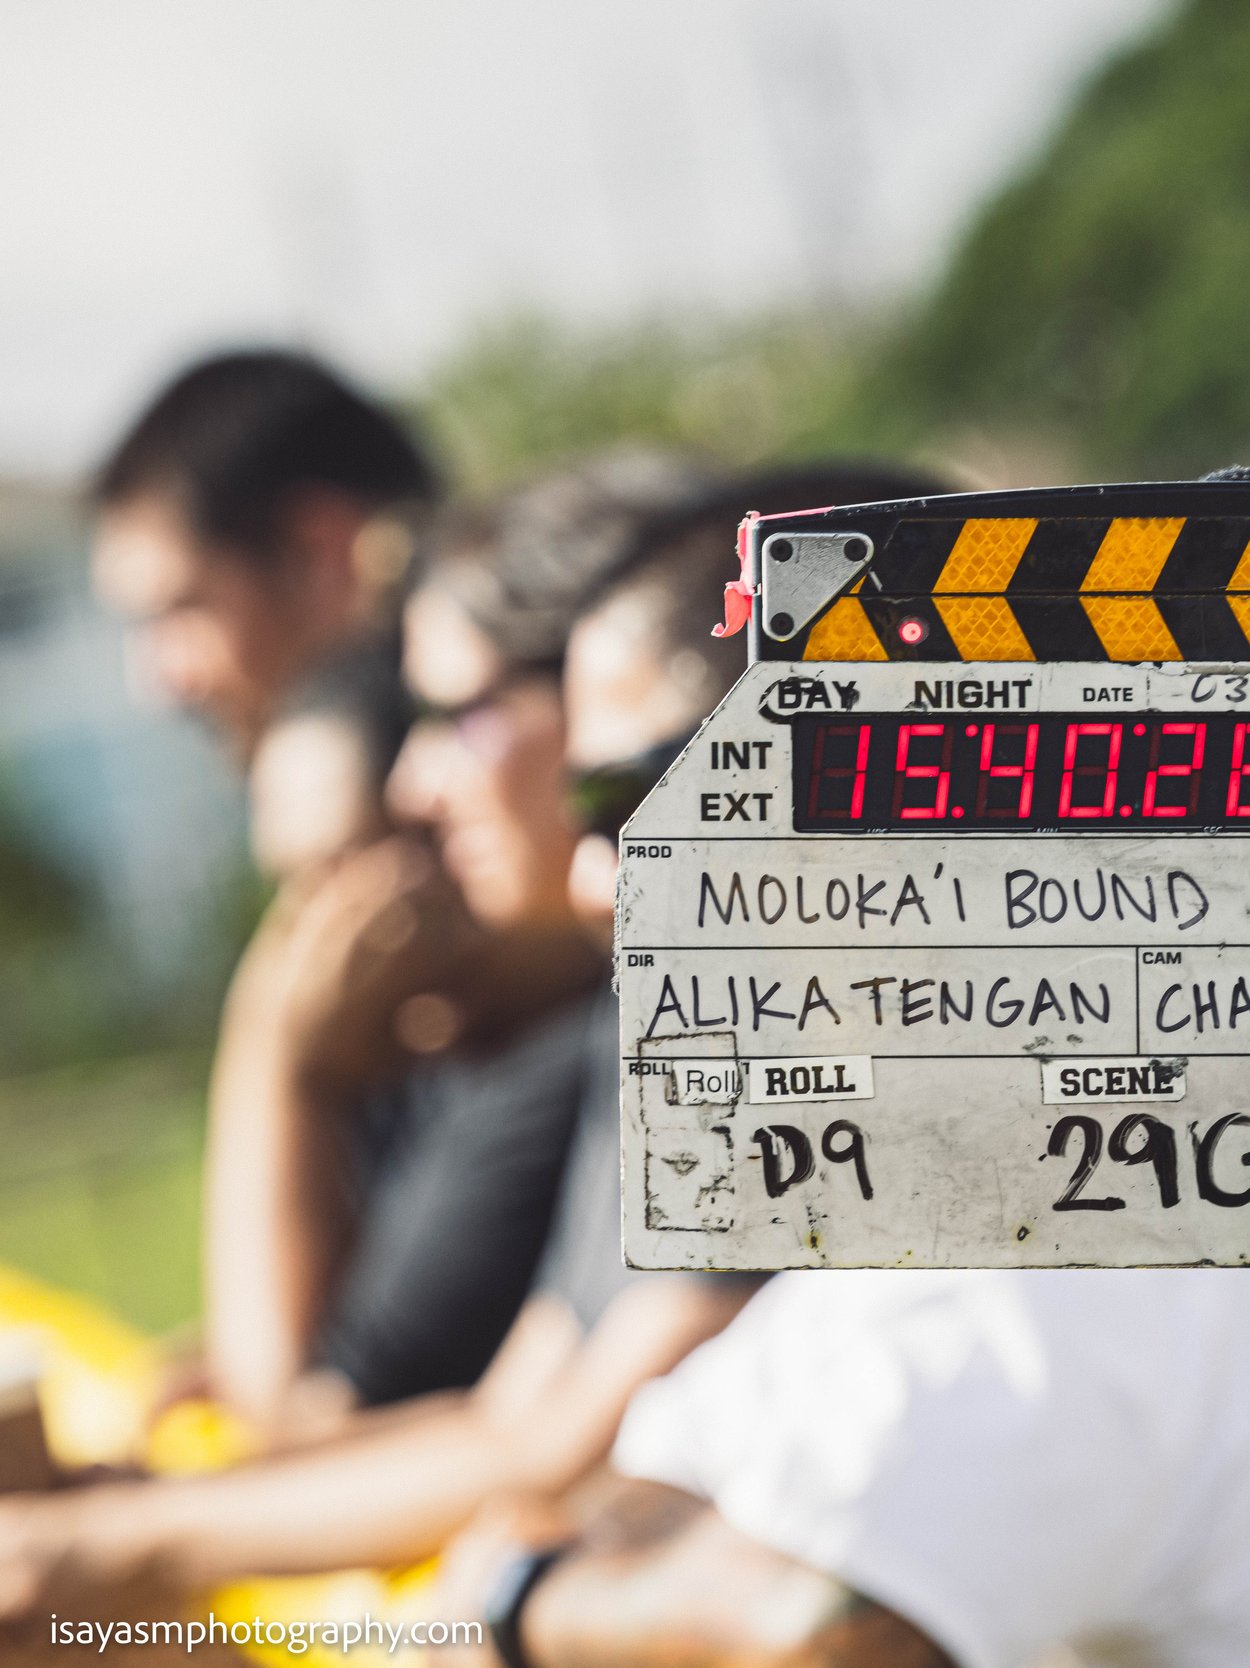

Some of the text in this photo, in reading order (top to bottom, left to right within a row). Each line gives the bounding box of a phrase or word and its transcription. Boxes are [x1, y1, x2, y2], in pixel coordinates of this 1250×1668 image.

[777, 680, 1033, 709] DAY NIGHT
[1083, 687, 1134, 702] DATE
[711, 742, 773, 769] INT
[700, 793, 773, 821] EXT
[627, 846, 672, 859] PROD
[1005, 867, 1211, 931] BOUND
[628, 955, 654, 967] DIR
[1142, 952, 1182, 964] CAM
[646, 974, 1110, 1038] ALIKA TENGAN
[629, 1063, 671, 1075] ROLL
[686, 1070, 736, 1093] Roll
[765, 1065, 856, 1096] ROLL
[1060, 1066, 1175, 1096] SCENE
